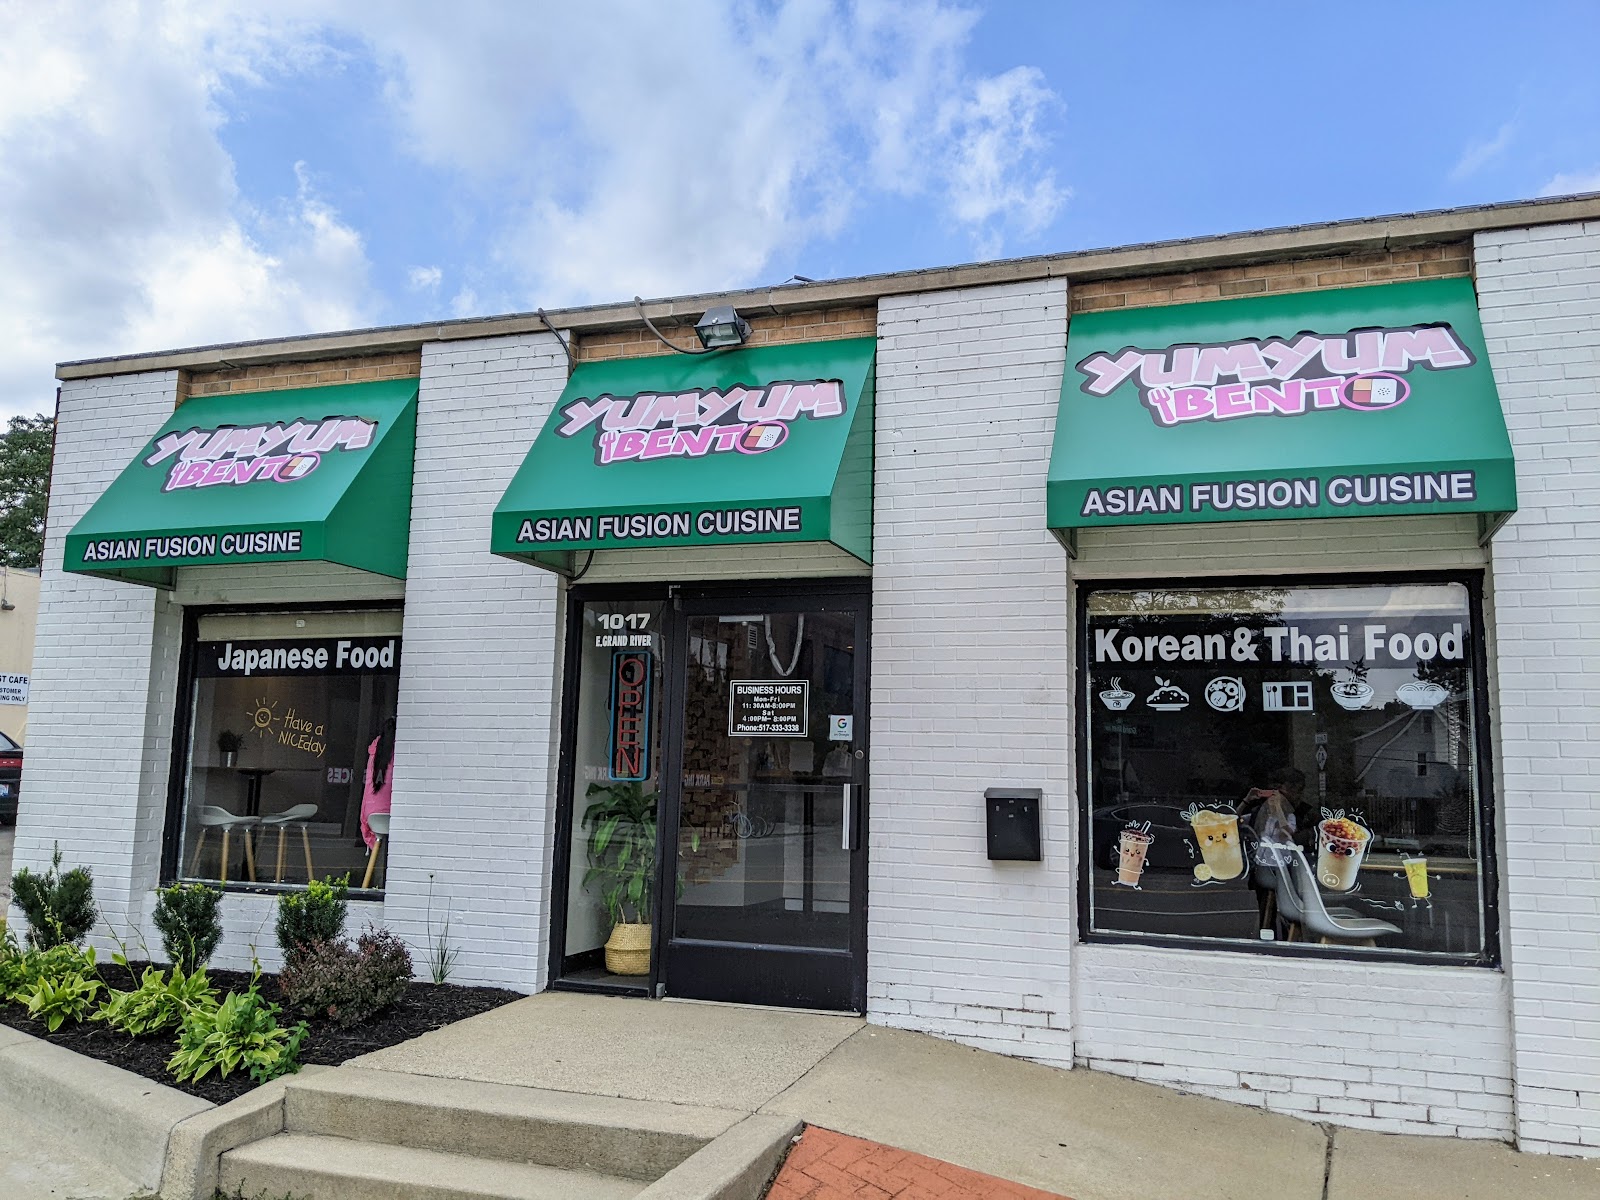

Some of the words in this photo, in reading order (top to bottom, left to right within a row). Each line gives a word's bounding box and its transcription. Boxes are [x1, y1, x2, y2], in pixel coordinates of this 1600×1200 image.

[1083, 486, 1182, 514] ASIAN
[1192, 480, 1317, 510] FUSION
[1328, 473, 1475, 506] CUISINE
[518, 518, 592, 541] ASIAN
[599, 513, 690, 538] FUSION
[697, 508, 801, 533] CUISINE
[83, 538, 140, 561] ASIAN
[145, 534, 216, 558] FUSION
[220, 531, 301, 554] CUISINE
[597, 613, 651, 630] 1017
[629, 634, 652, 647] RIVER
[1264, 624, 1350, 662] Thai
[1364, 623, 1464, 660] Food
[217, 642, 328, 676] Japanese
[335, 639, 395, 669] Food
[8, 675, 28, 685] CAFE
[736, 685, 775, 695] BUSINESS
[774, 685, 802, 695] HOURS
[284, 707, 313, 733] Have
[314, 724, 324, 736] a
[616, 658, 645, 775] OPEN
